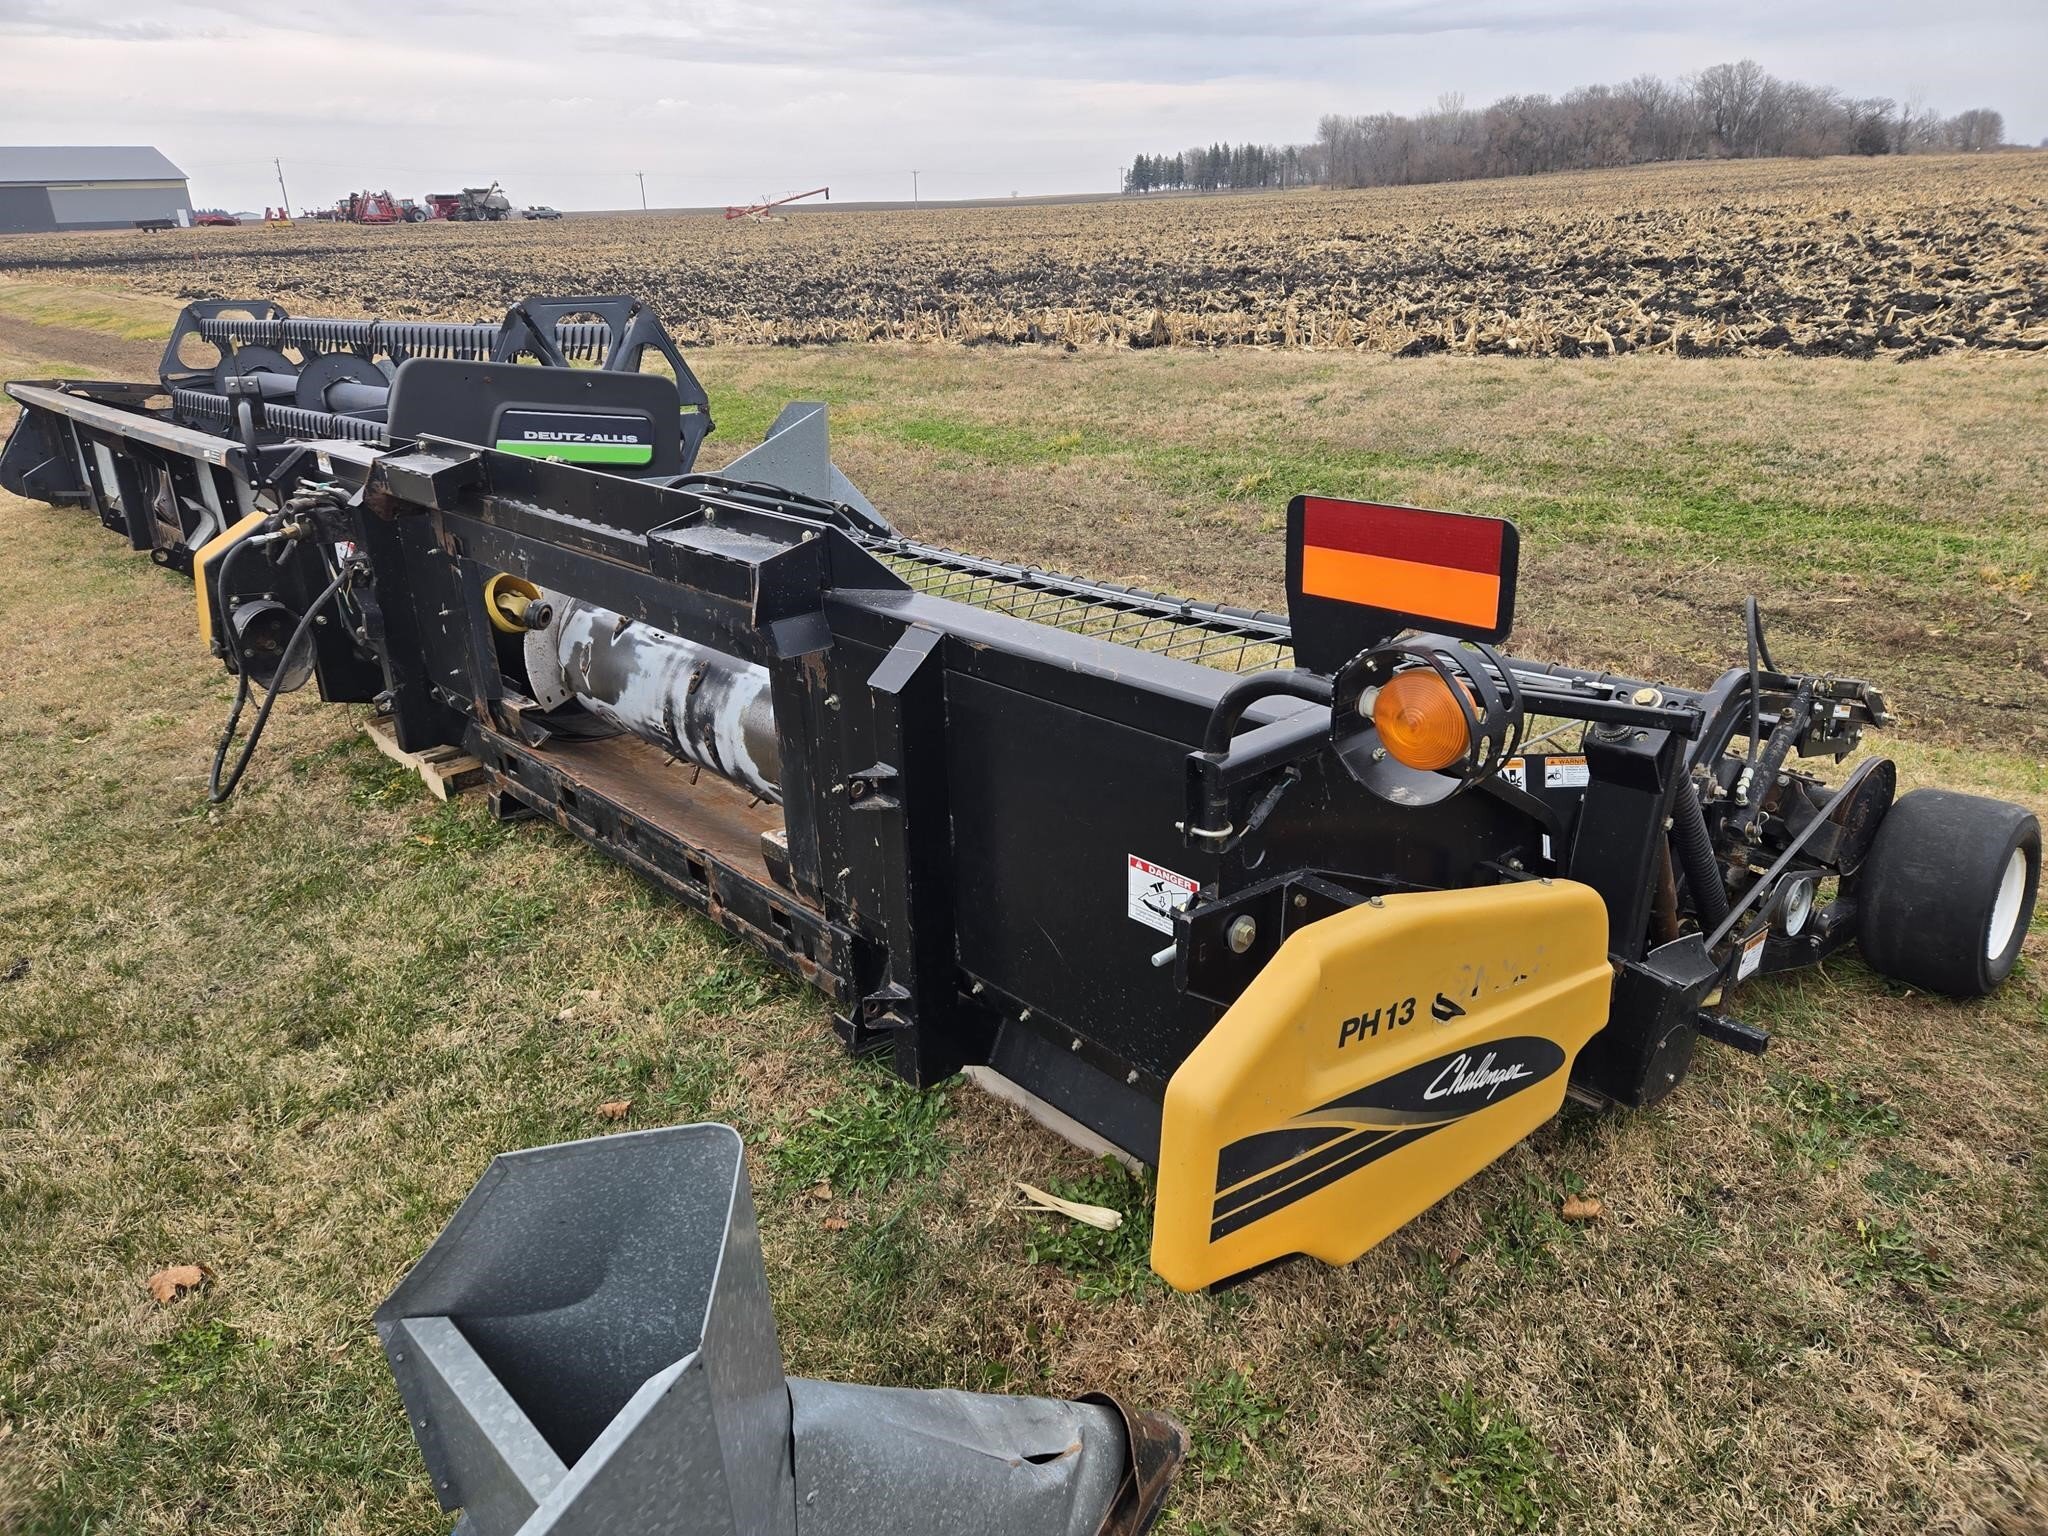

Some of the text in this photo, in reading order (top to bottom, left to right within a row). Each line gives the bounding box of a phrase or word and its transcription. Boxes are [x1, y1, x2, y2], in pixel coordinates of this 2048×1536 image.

[523, 431, 638, 443] DEUTZ-ALLIS
[1148, 866, 1192, 890] DANGER
[1423, 1052, 1534, 1100] Challenger
